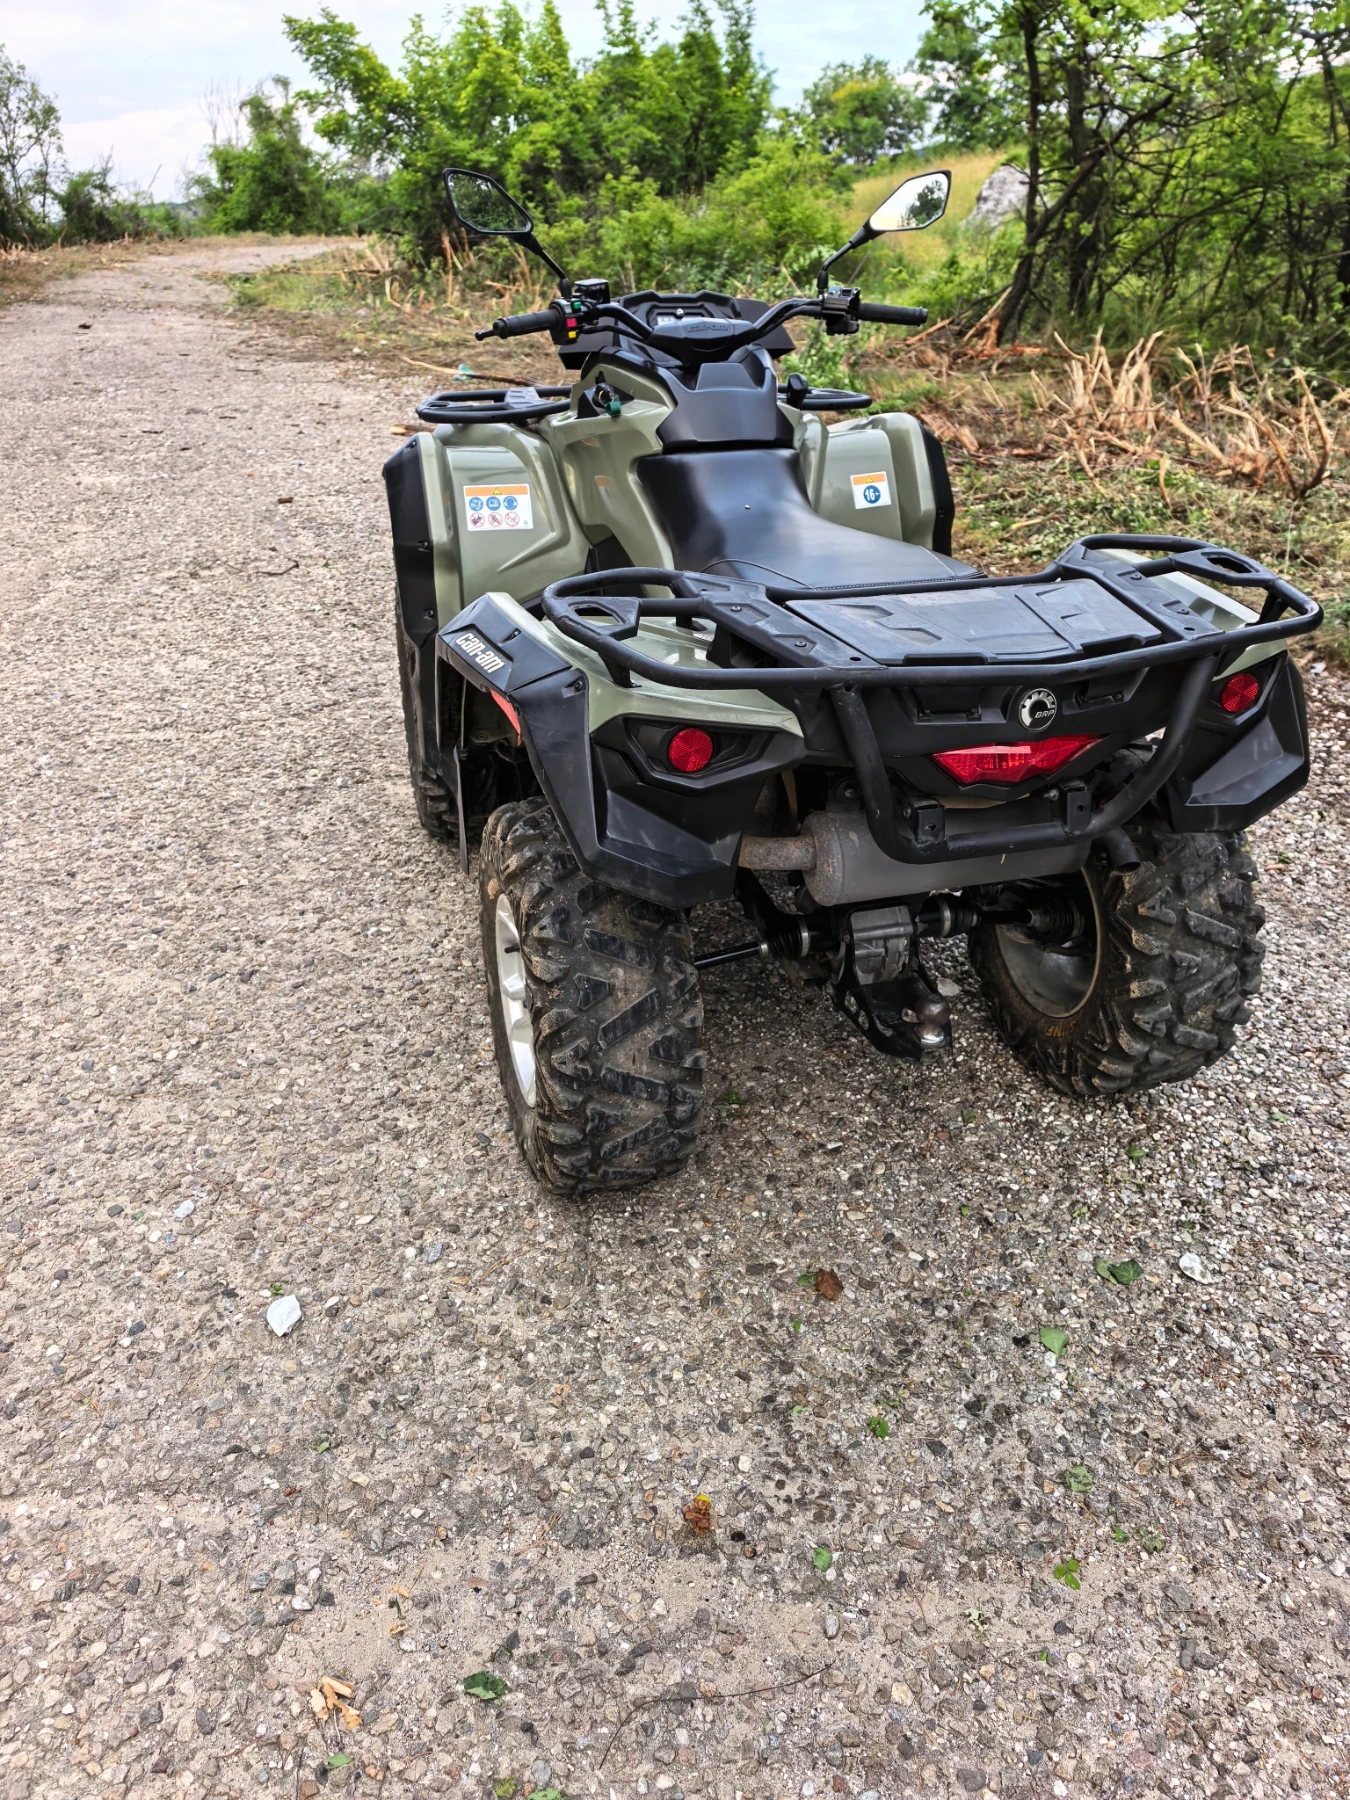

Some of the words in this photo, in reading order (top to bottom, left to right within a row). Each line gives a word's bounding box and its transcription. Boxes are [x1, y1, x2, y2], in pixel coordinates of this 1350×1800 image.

[865, 488, 880, 501] 16+
[455, 632, 505, 674] can-am
[1034, 709, 1055, 719] BRP
